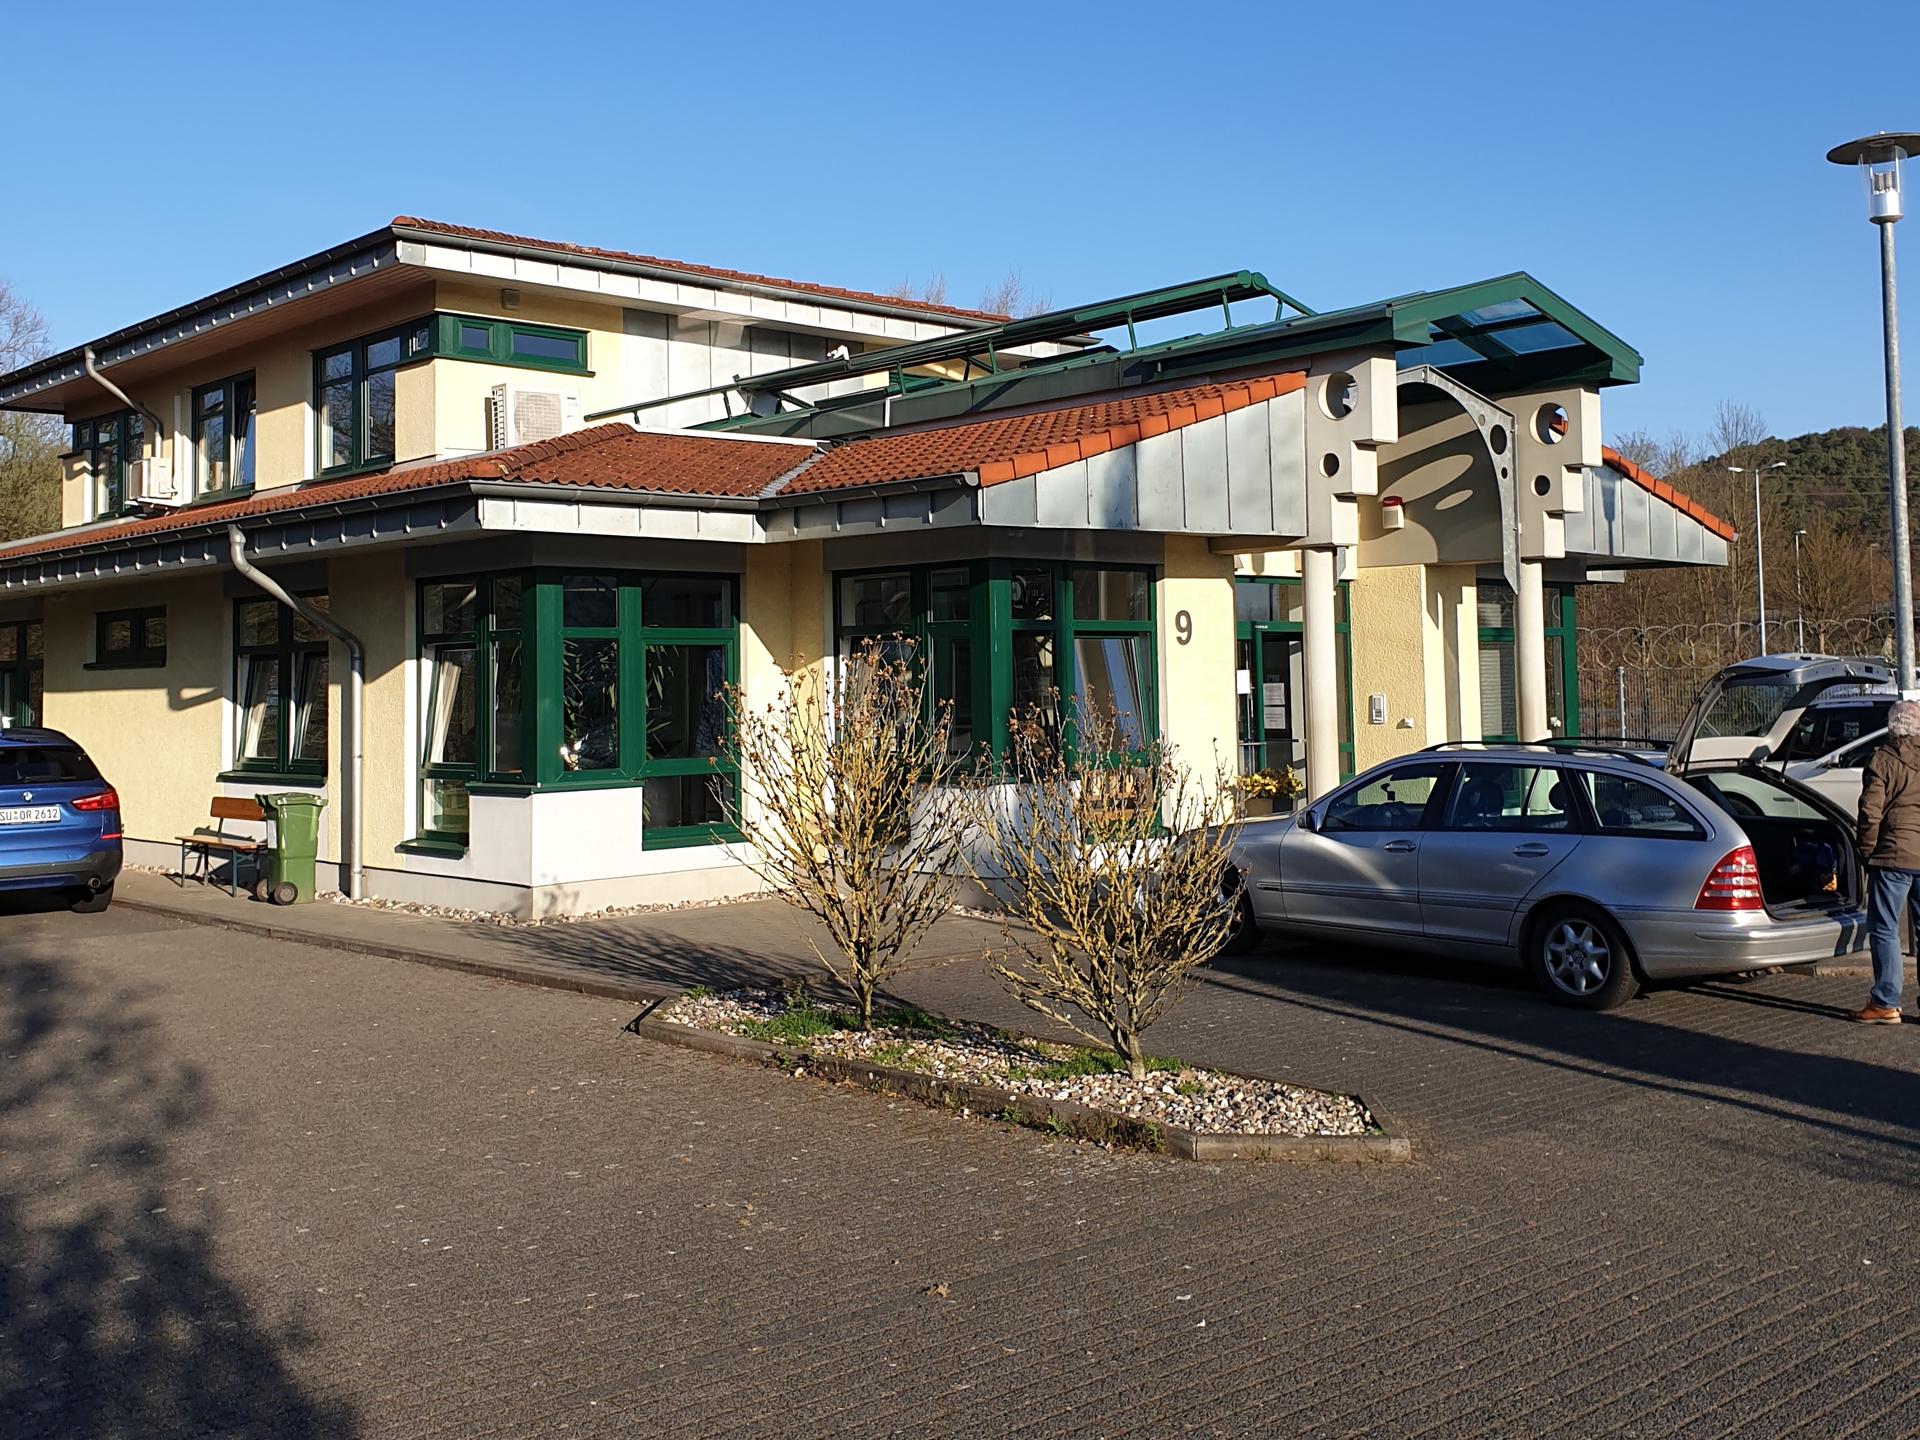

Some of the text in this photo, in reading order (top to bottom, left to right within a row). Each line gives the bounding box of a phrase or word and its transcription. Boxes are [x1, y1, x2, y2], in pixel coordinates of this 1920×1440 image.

[1175, 610, 1192, 645] 9
[0, 809, 58, 821] SU OR 2612
